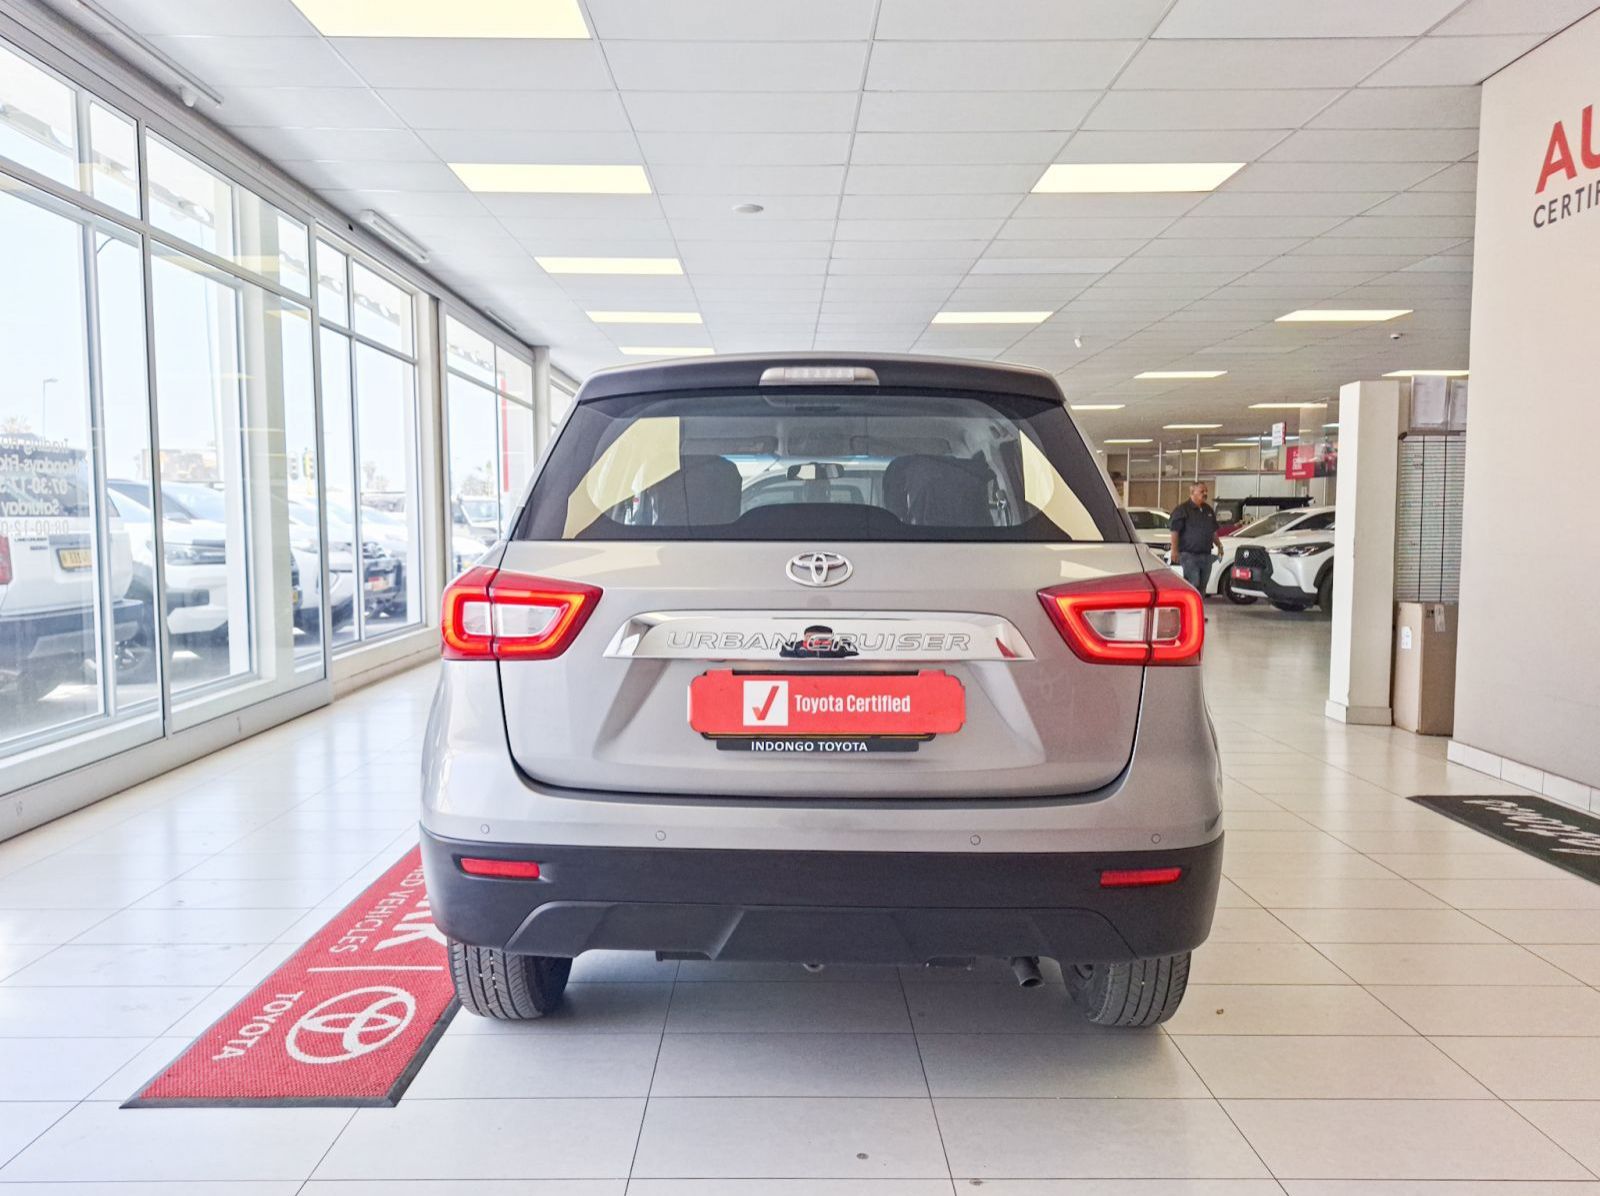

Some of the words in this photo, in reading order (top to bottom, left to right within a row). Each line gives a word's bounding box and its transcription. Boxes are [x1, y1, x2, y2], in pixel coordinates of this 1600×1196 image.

[667, 631, 798, 650] URBAN
[803, 632, 970, 651] CRUISER
[795, 694, 843, 714] Toyota
[846, 694, 911, 713] Certified
[751, 740, 814, 752] INDONGO
[817, 741, 868, 752] TOYOTA
[329, 889, 415, 953] VEHICLES
[212, 990, 304, 1061] TOYOTA
